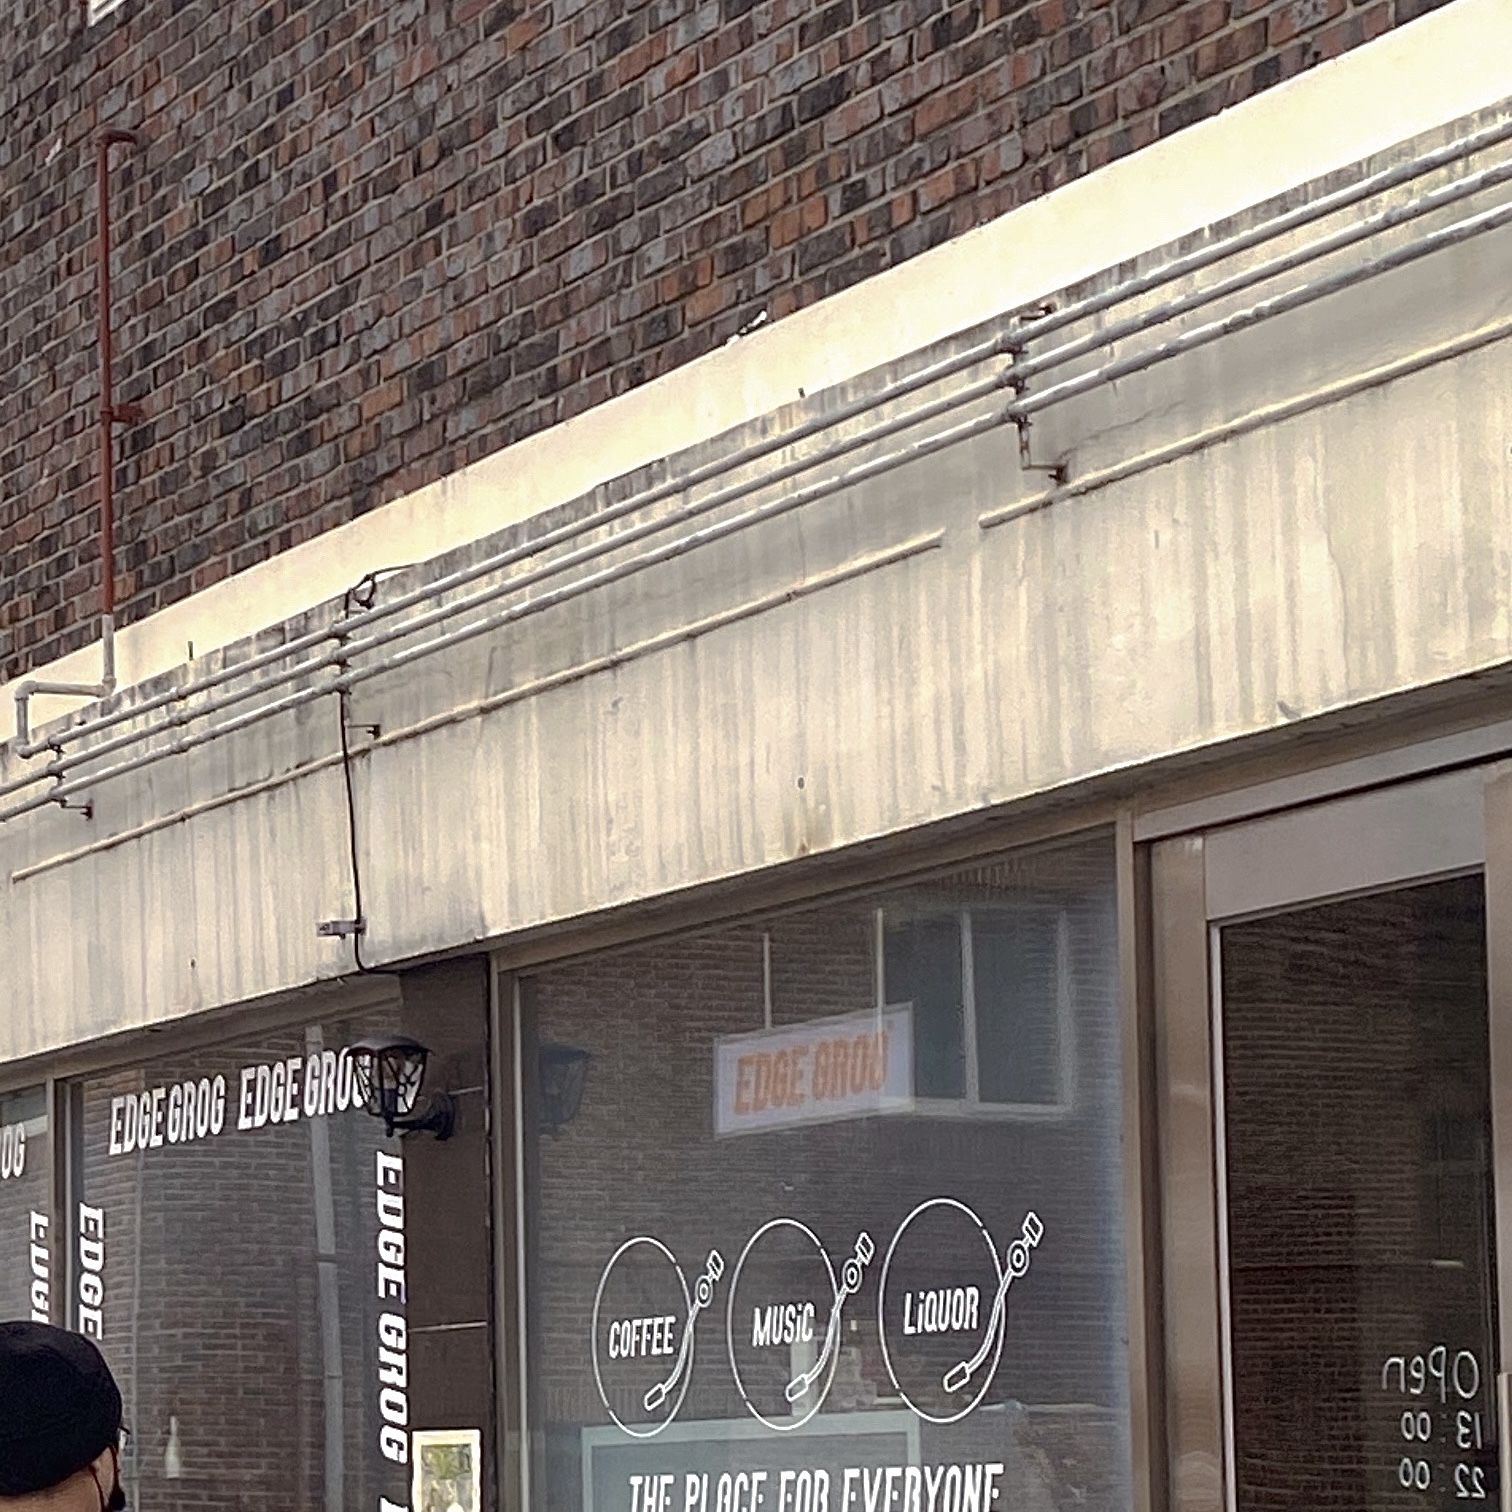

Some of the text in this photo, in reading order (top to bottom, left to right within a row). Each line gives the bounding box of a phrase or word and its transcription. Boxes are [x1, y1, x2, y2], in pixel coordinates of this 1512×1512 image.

[108, 1087, 166, 1156] EDGE
[166, 1074, 226, 1144] GROG
[238, 1057, 302, 1131] EDGE
[734, 1045, 809, 1115] EDGE
[79, 1201, 105, 1341] EDGE
[376, 1150, 406, 1305] EDGE
[378, 1312, 408, 1465] GROG
[609, 1316, 676, 1358] COFFEE
